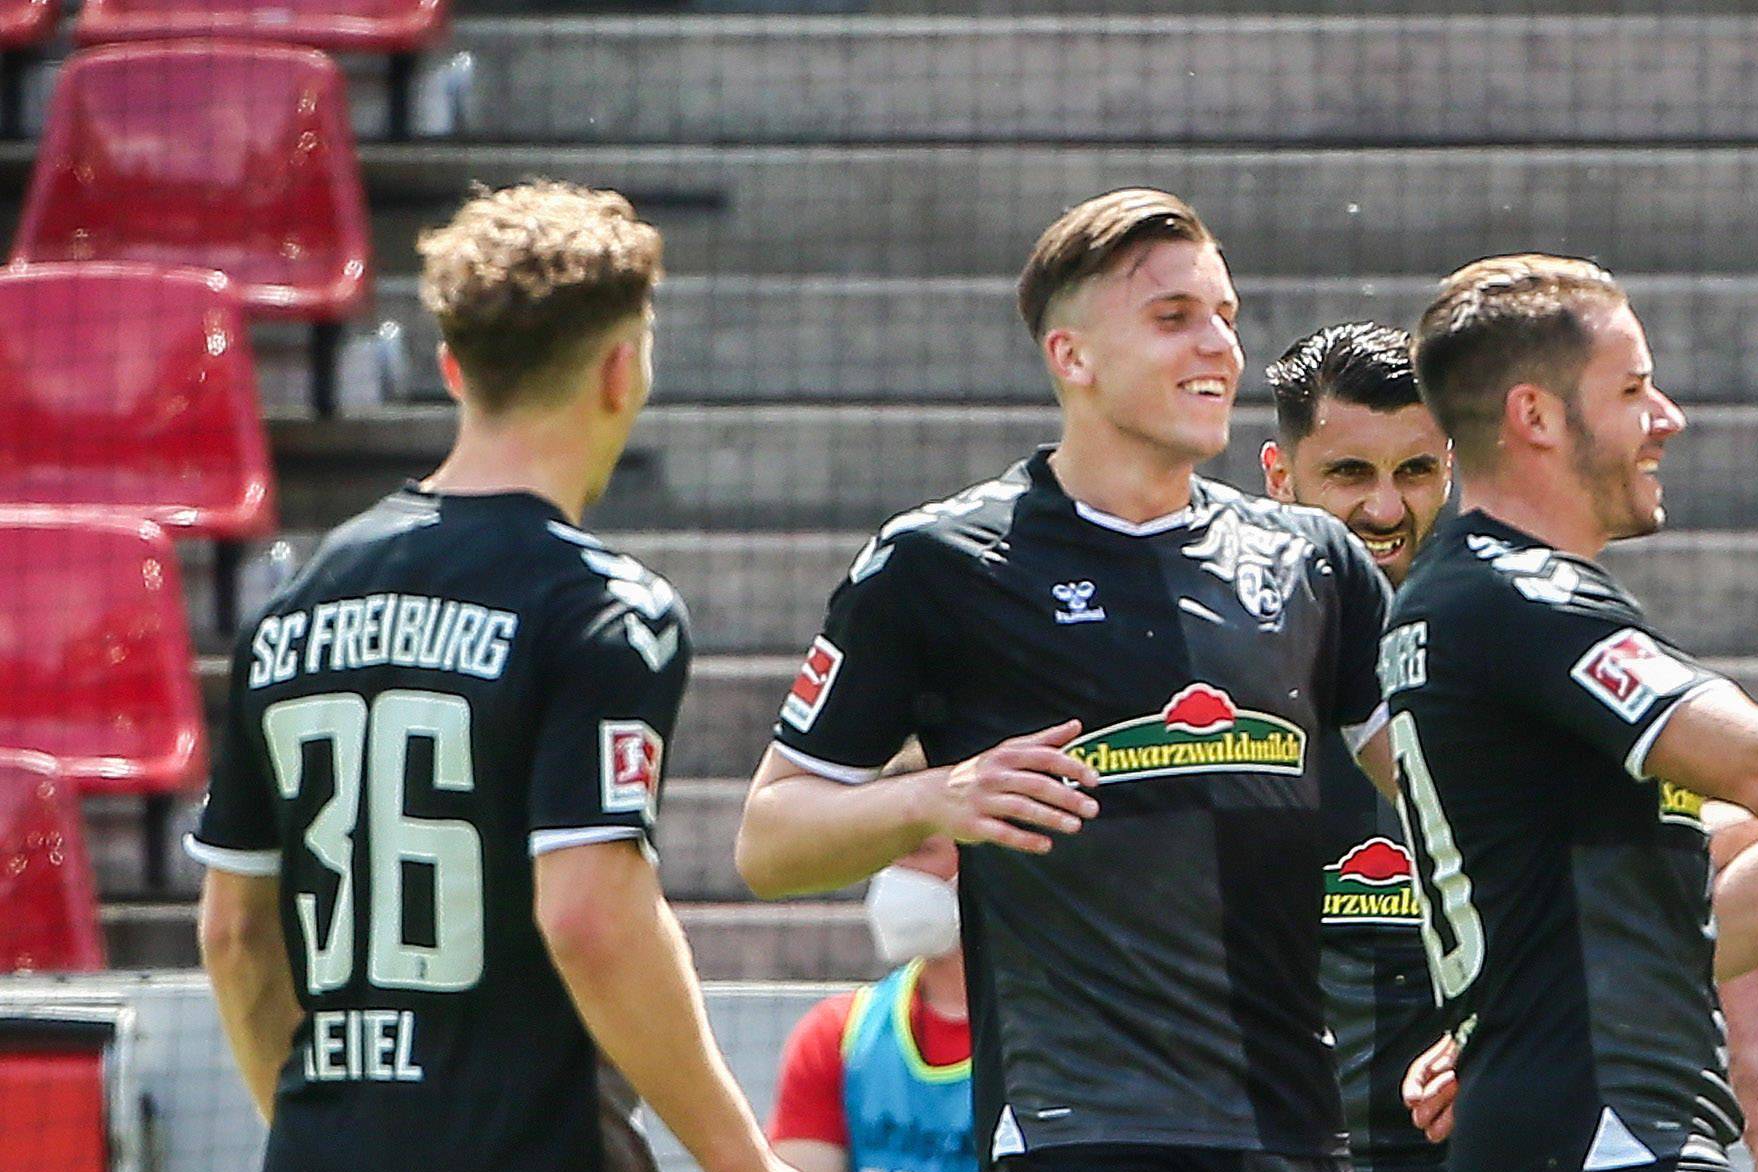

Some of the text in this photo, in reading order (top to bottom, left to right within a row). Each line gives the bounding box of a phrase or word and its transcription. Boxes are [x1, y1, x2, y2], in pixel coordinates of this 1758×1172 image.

[251, 593, 519, 689] SC FREIBURG
[261, 688, 485, 995] 36
